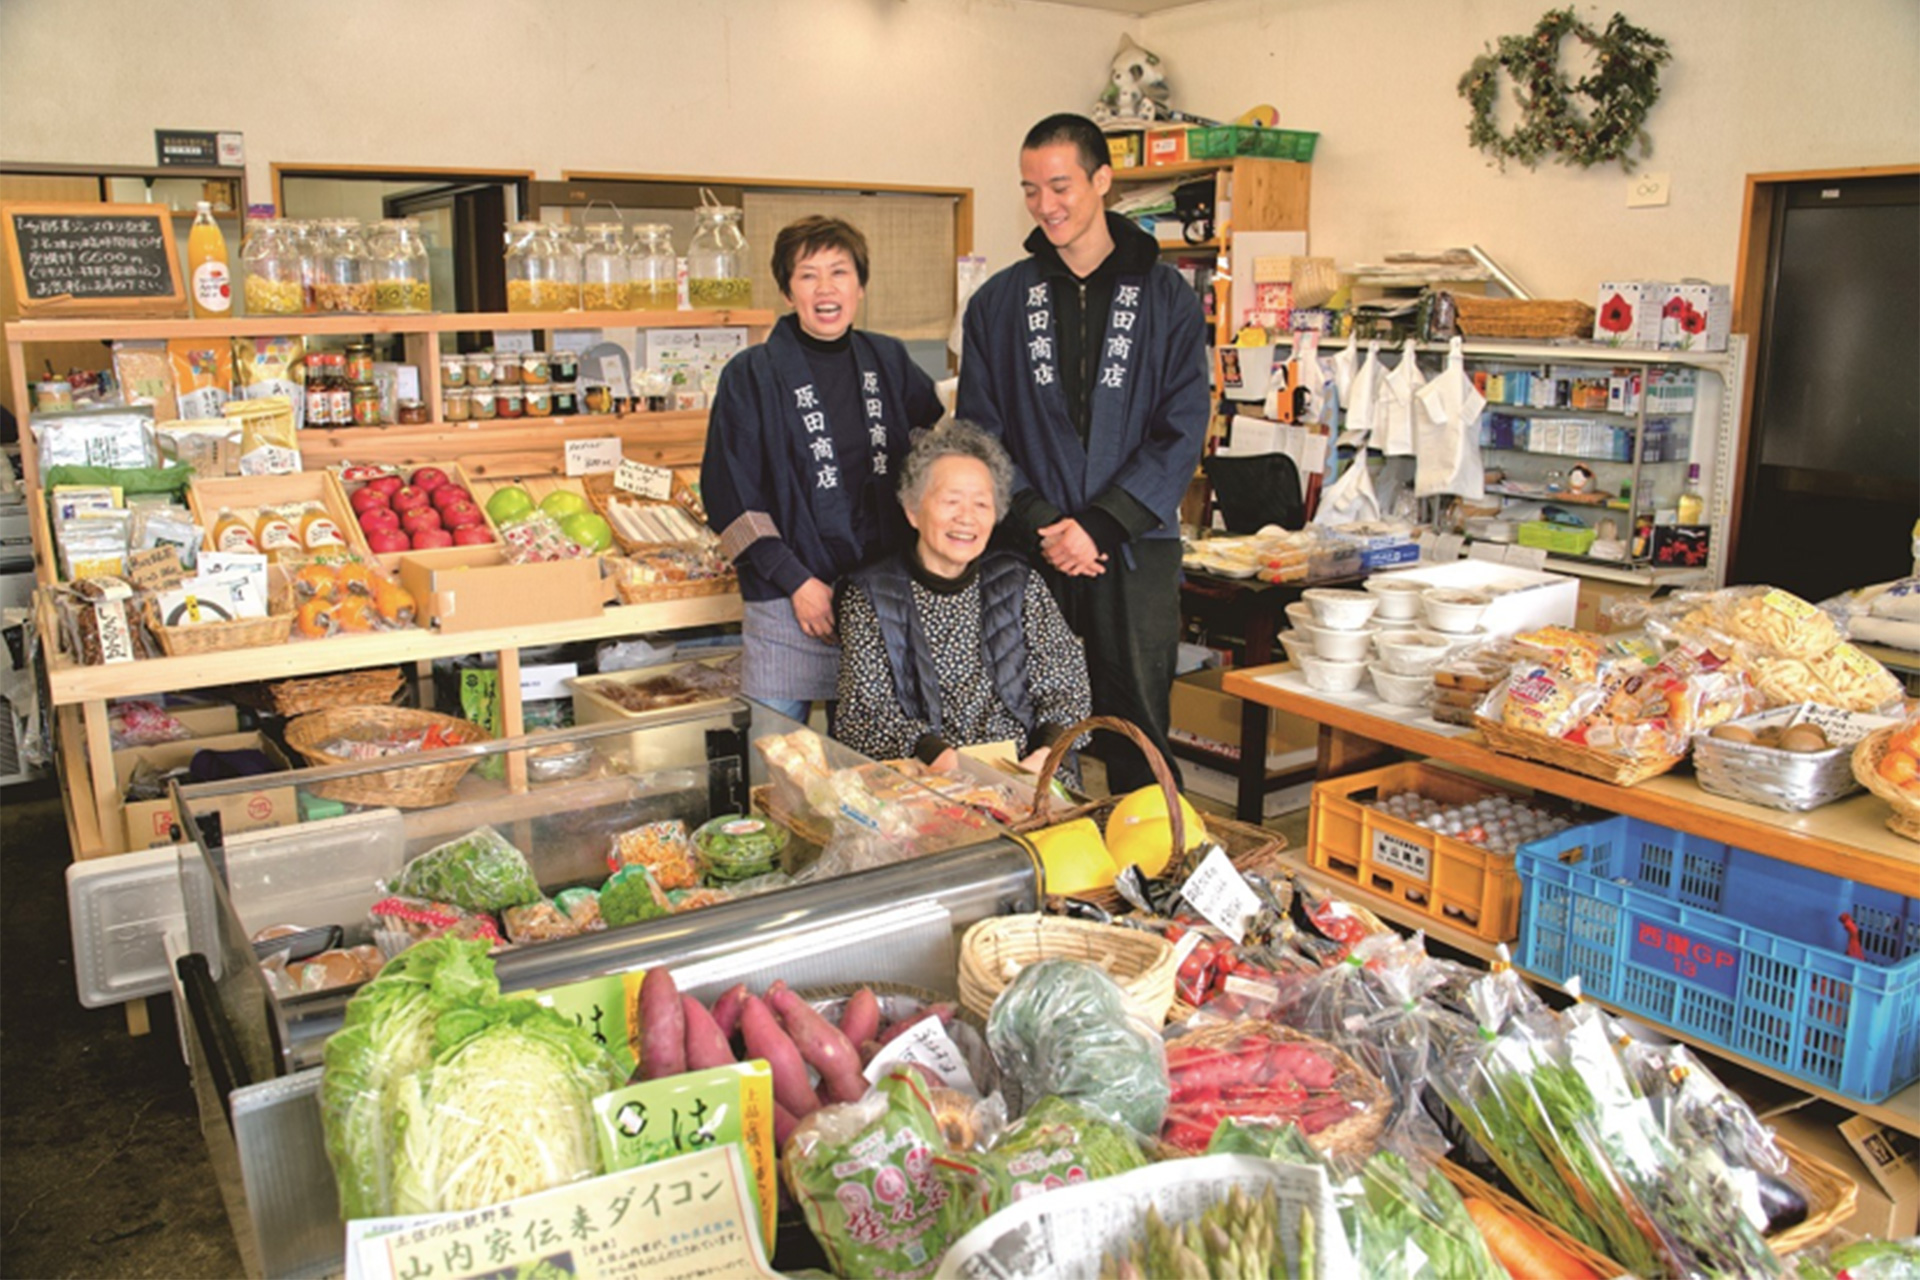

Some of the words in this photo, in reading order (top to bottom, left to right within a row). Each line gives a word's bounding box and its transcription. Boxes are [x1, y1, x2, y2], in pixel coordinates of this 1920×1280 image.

[1026, 282, 1055, 385] 原田商店
[1101, 285, 1140, 388] 原田商店
[794, 384, 838, 489] 原田商店
[862, 371, 889, 475] 原田商店
[1673, 957, 1697, 978] 13
[396, 1205, 514, 1248] 土佐の伝統野菜
[400, 1172, 723, 1280] 山内家伝来ダイコン
